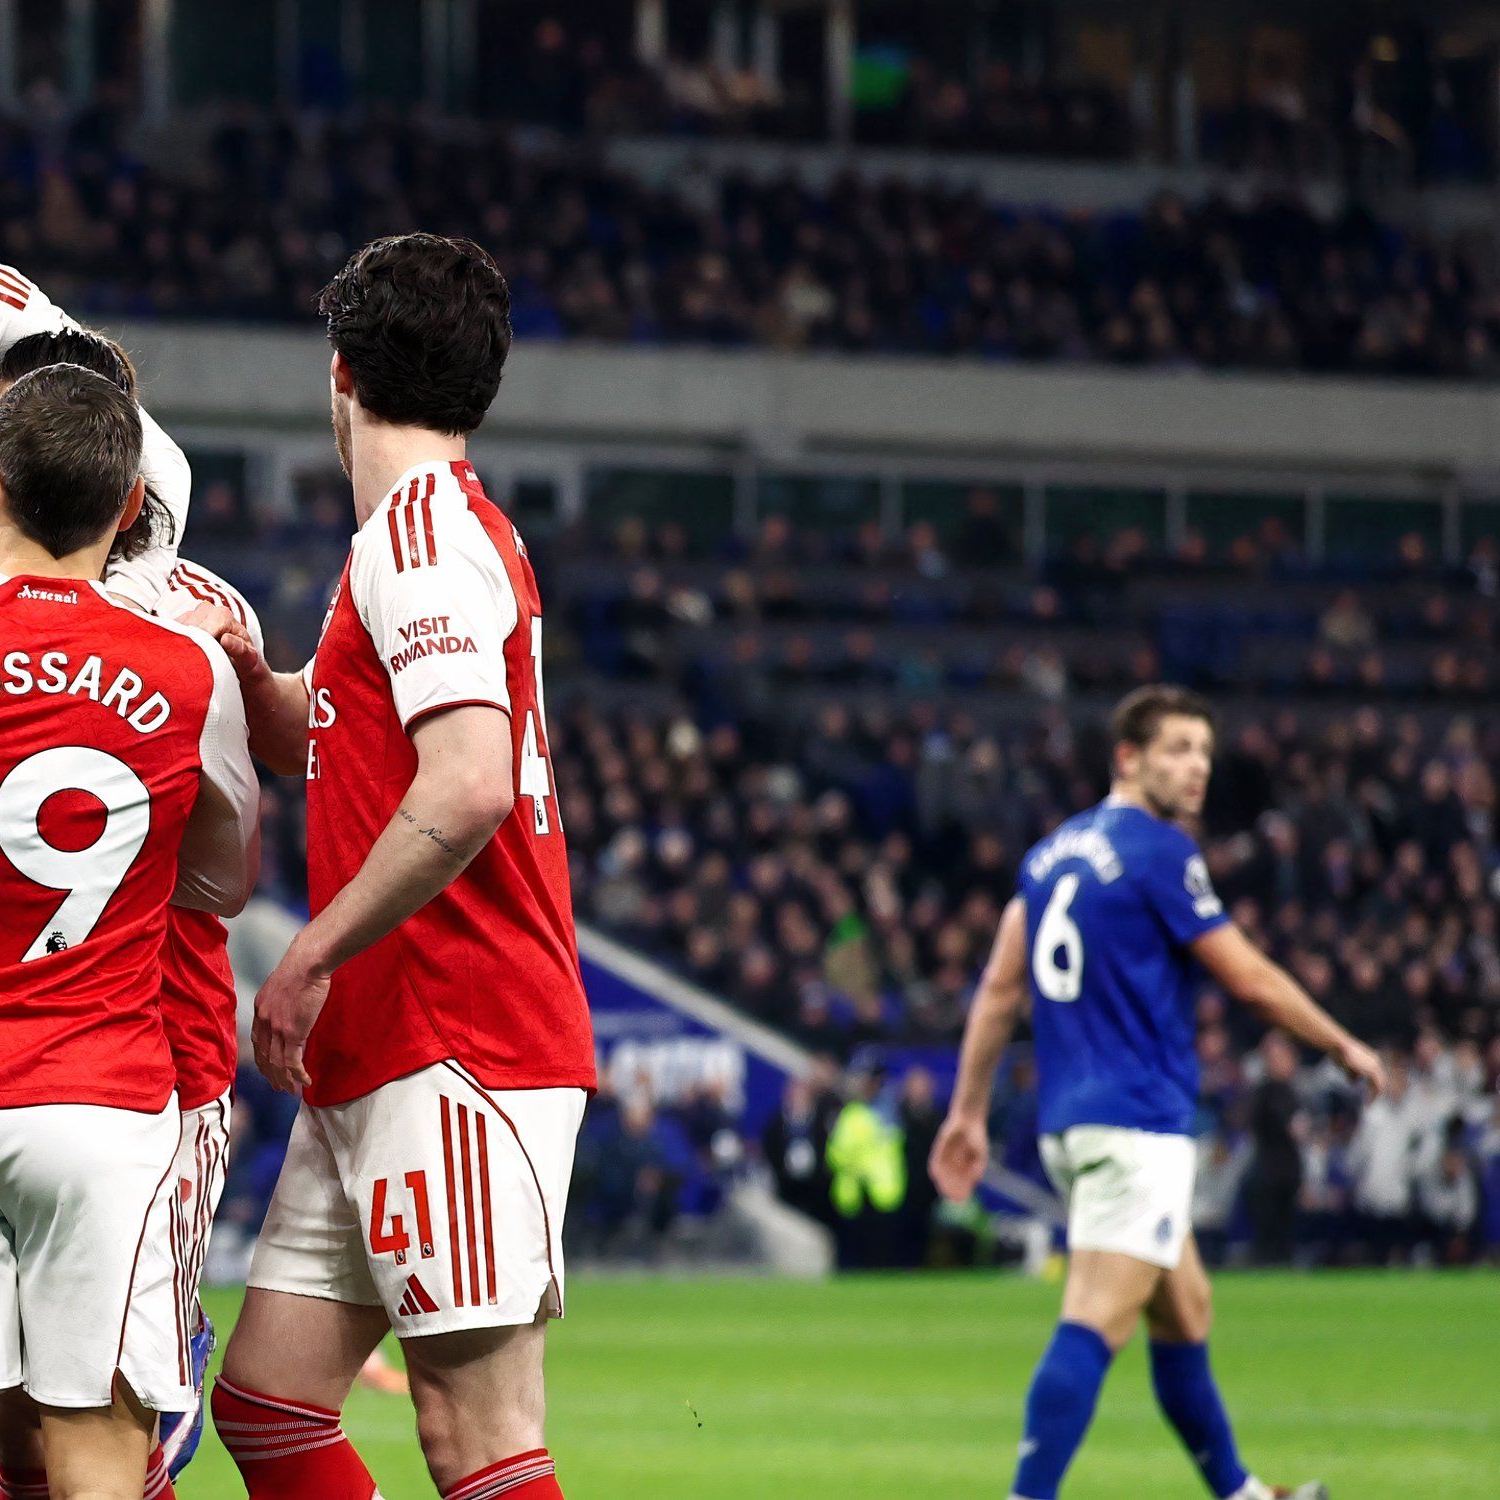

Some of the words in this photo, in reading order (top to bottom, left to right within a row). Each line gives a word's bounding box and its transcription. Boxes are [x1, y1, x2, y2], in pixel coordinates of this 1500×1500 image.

[16, 584, 78, 605] Arsenal
[397, 616, 450, 643] VISIT
[390, 636, 478, 675] RWANDA
[1032, 872, 1083, 1002] 6
[369, 1169, 435, 1265] 41
